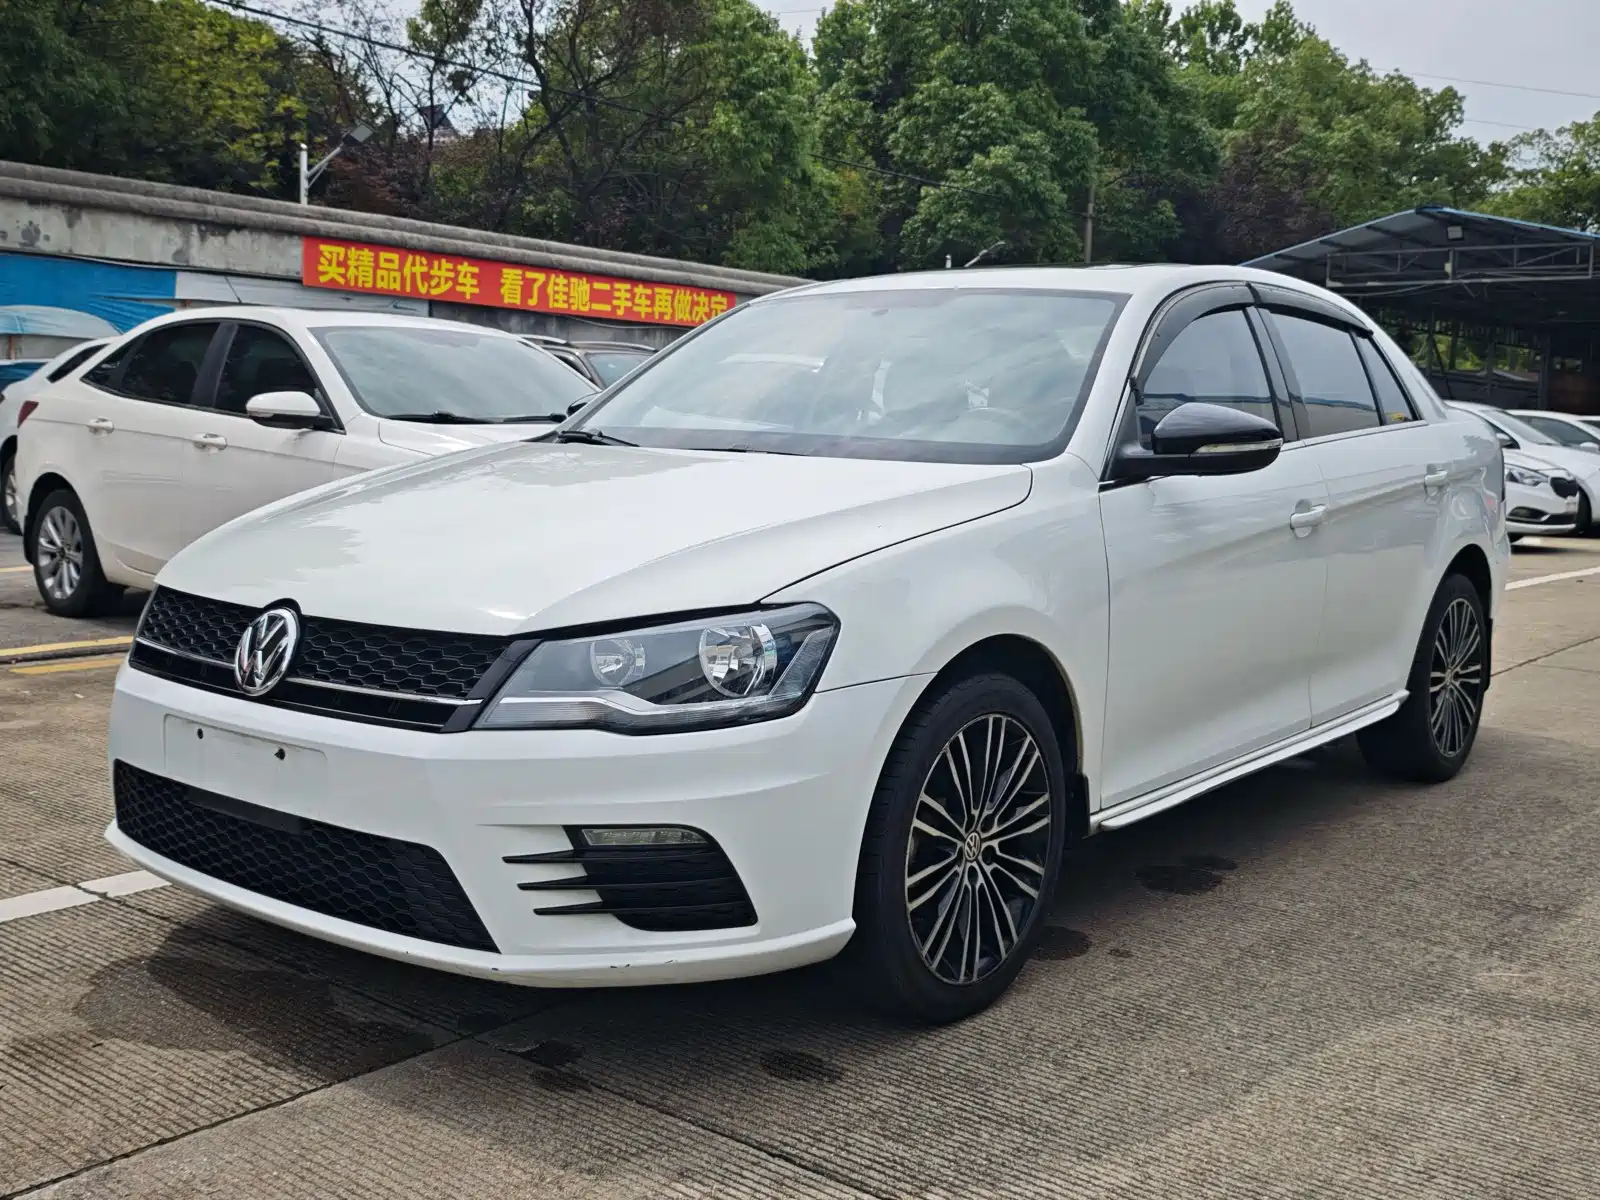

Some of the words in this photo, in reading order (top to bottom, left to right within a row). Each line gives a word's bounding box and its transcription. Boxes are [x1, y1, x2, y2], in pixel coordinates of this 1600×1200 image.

[317, 244, 480, 299] 买精品代步车
[500, 268, 728, 322] 看了佳驰二手车再做决定
